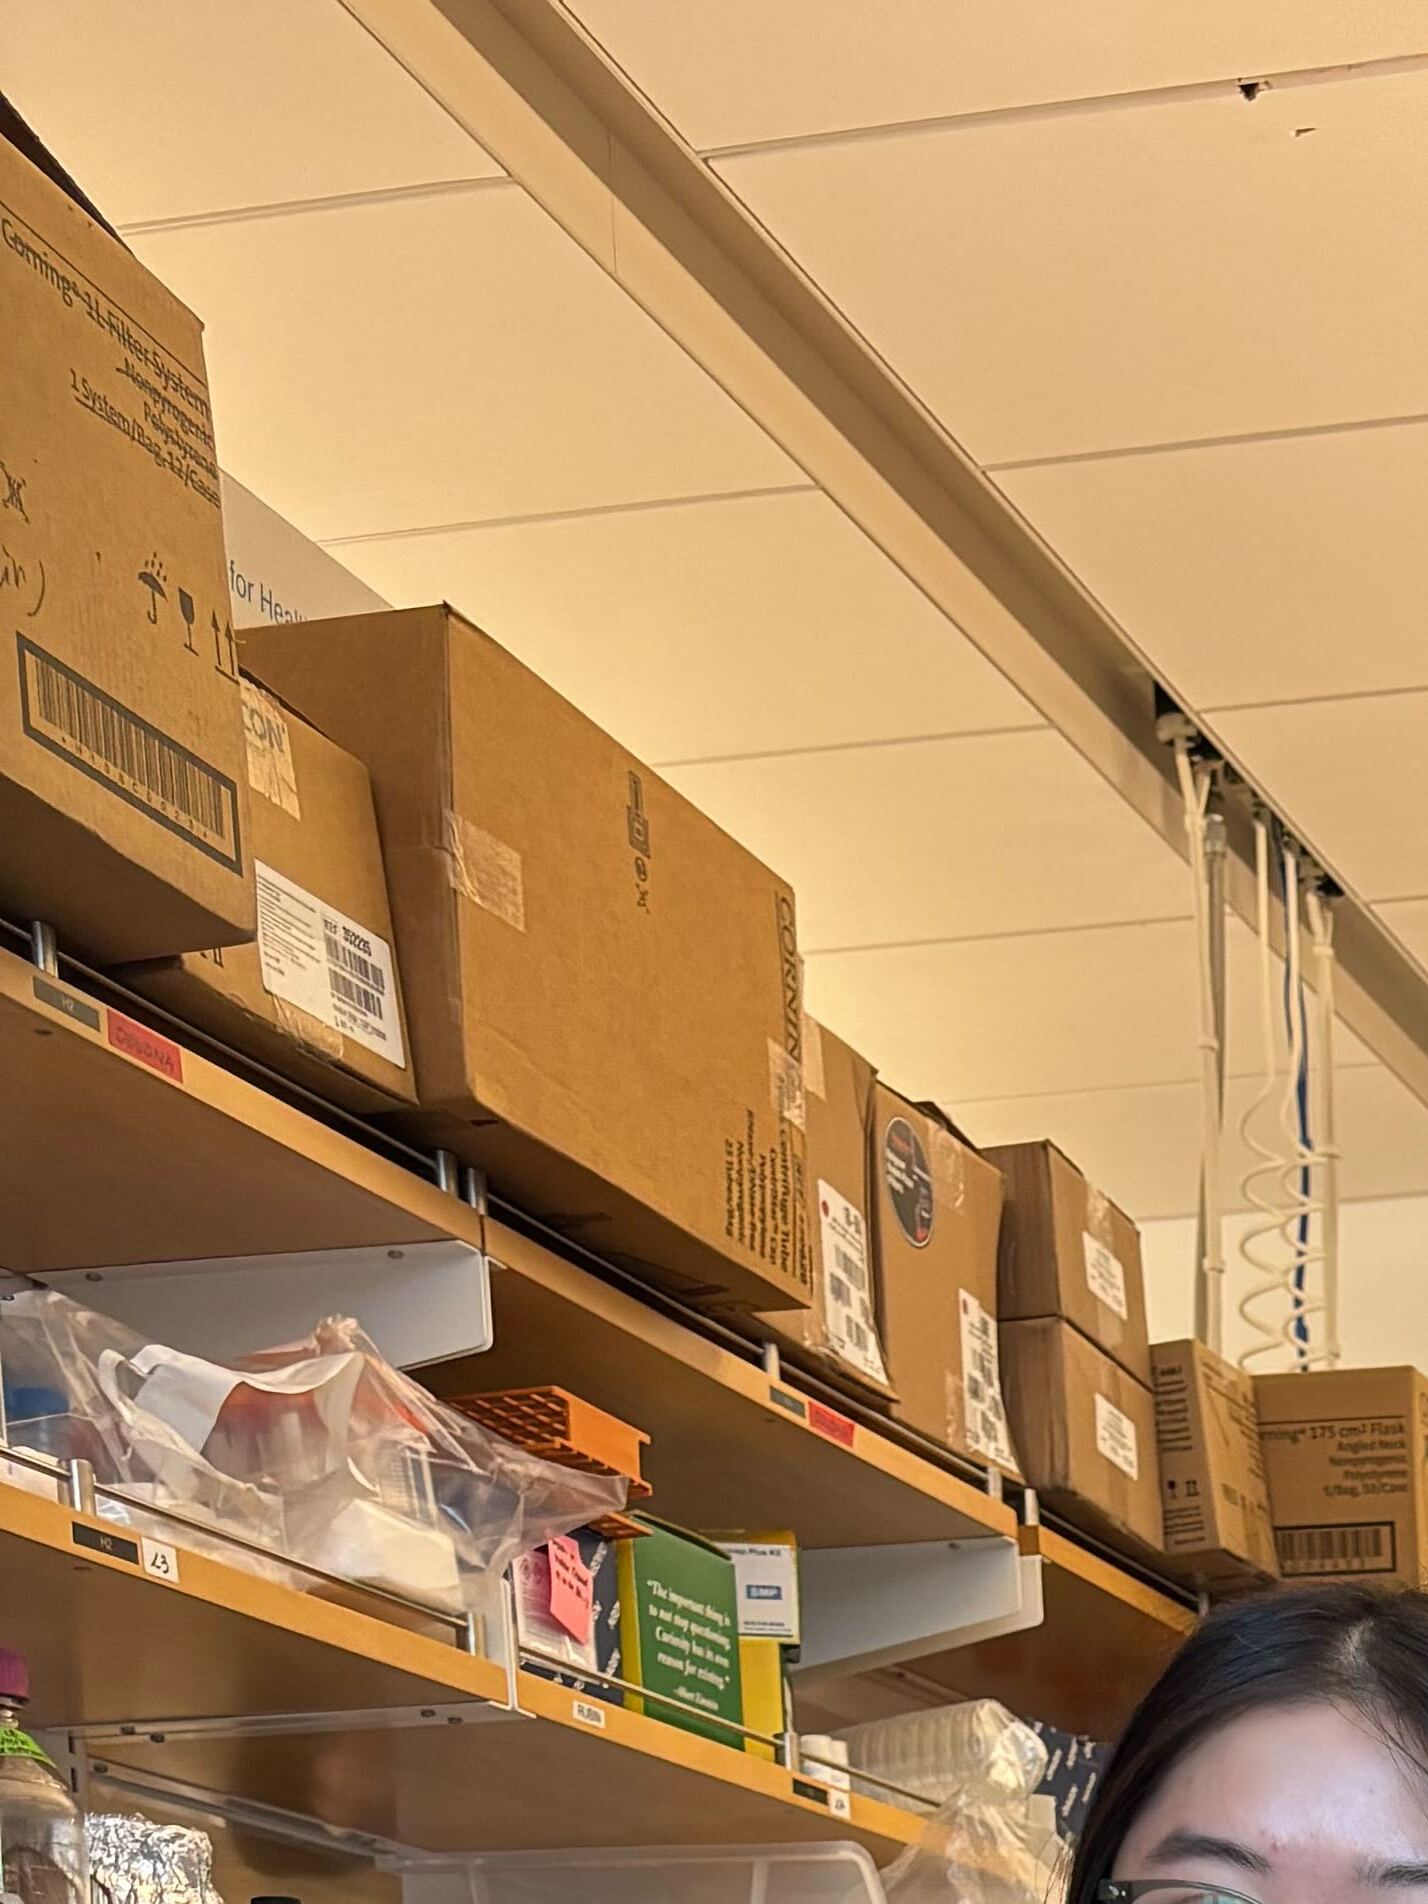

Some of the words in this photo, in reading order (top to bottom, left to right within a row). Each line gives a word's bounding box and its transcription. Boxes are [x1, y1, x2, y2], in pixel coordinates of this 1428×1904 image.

[229, 559, 255, 600] for
[260, 583, 309, 625] Heal
[777, 895, 802, 1060] CORNIN
[1310, 1425, 1335, 1440] 175
